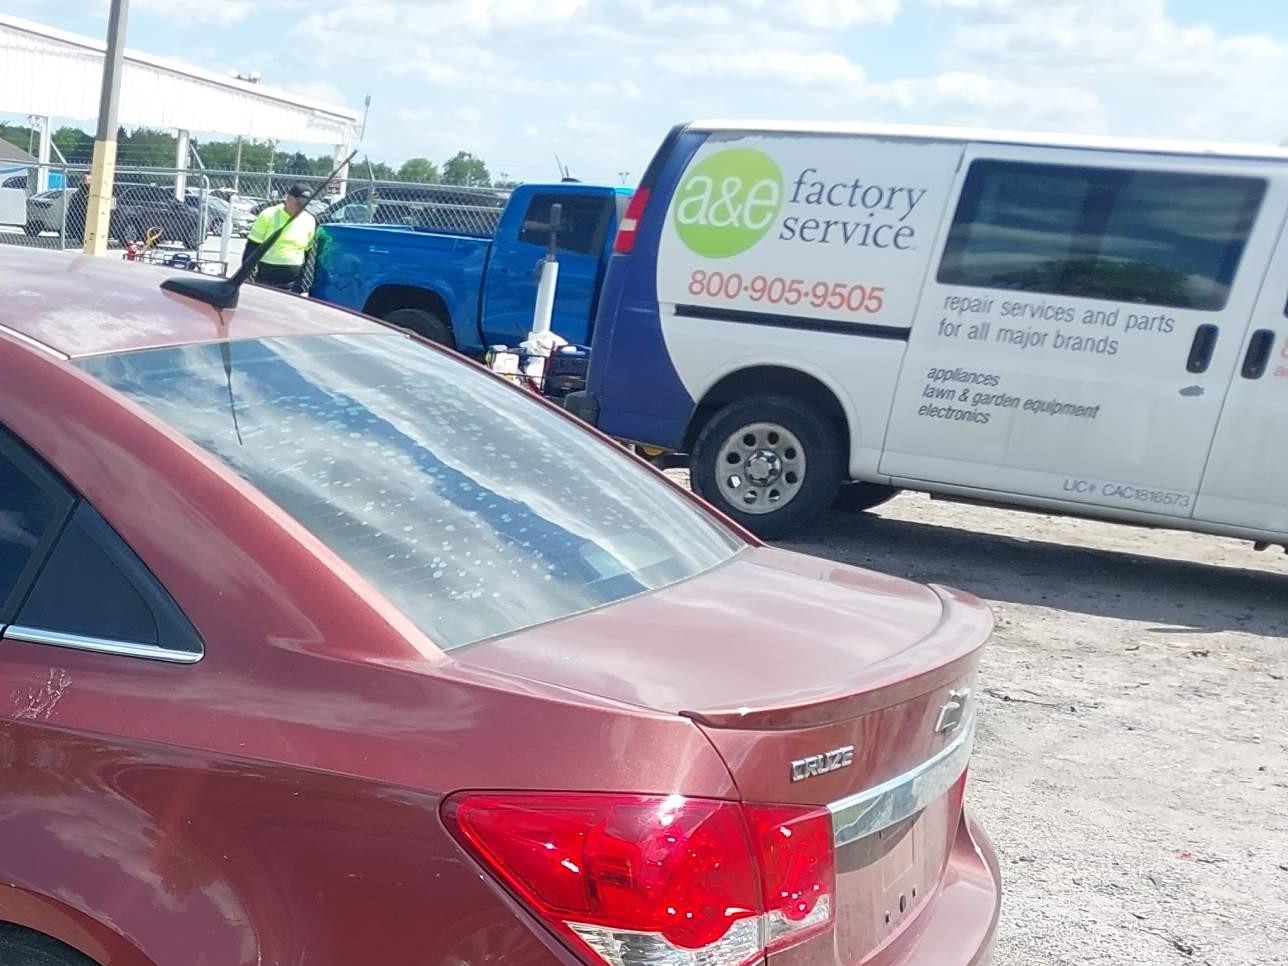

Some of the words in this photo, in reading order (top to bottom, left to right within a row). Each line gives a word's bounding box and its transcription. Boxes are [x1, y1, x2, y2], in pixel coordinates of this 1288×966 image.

[676, 175, 780, 229] a&e
[789, 168, 927, 222] factory
[778, 213, 916, 250] service
[943, 295, 994, 315] repair
[1000, 300, 1075, 324] services
[1082, 308, 1120, 327] and
[1124, 313, 1176, 334] parts
[938, 318, 962, 337] for
[967, 322, 991, 341] all
[996, 327, 1048, 349] major
[1053, 330, 1120, 356] brands
[927, 367, 1000, 387] appliances
[918, 403, 990, 424] electronics
[922, 384, 956, 400] lawn
[958, 388, 970, 402] &
[971, 392, 1021, 409] garden
[1023, 398, 1100, 419] equipment
[791, 745, 855, 782] CRUZE
